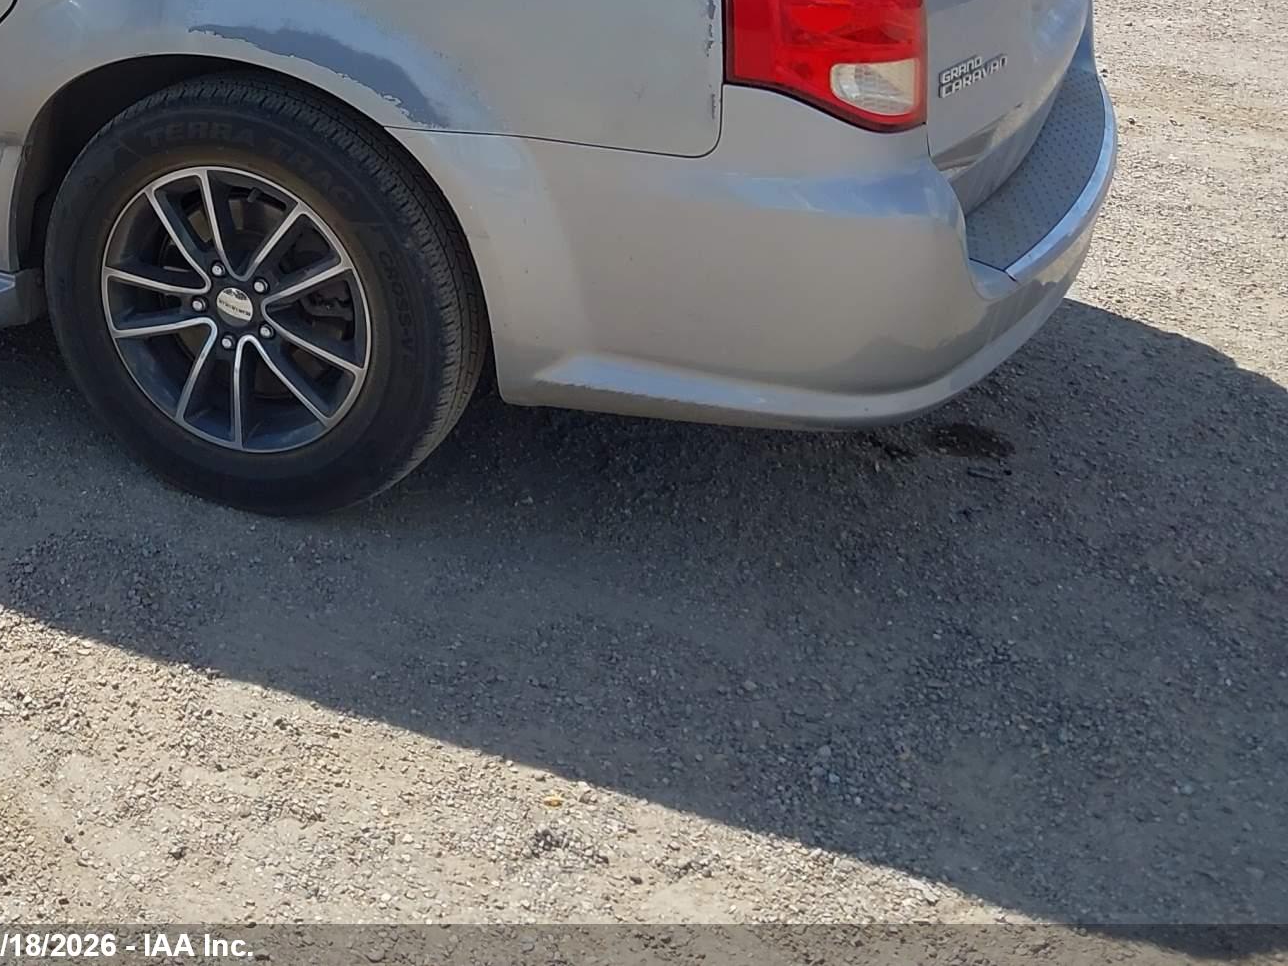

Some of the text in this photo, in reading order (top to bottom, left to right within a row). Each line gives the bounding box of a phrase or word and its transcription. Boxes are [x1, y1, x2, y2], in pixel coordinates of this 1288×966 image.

[940, 56, 983, 85] GRAND
[940, 56, 1008, 99] CARAVAN
[143, 121, 355, 203] TERRA TRAC
